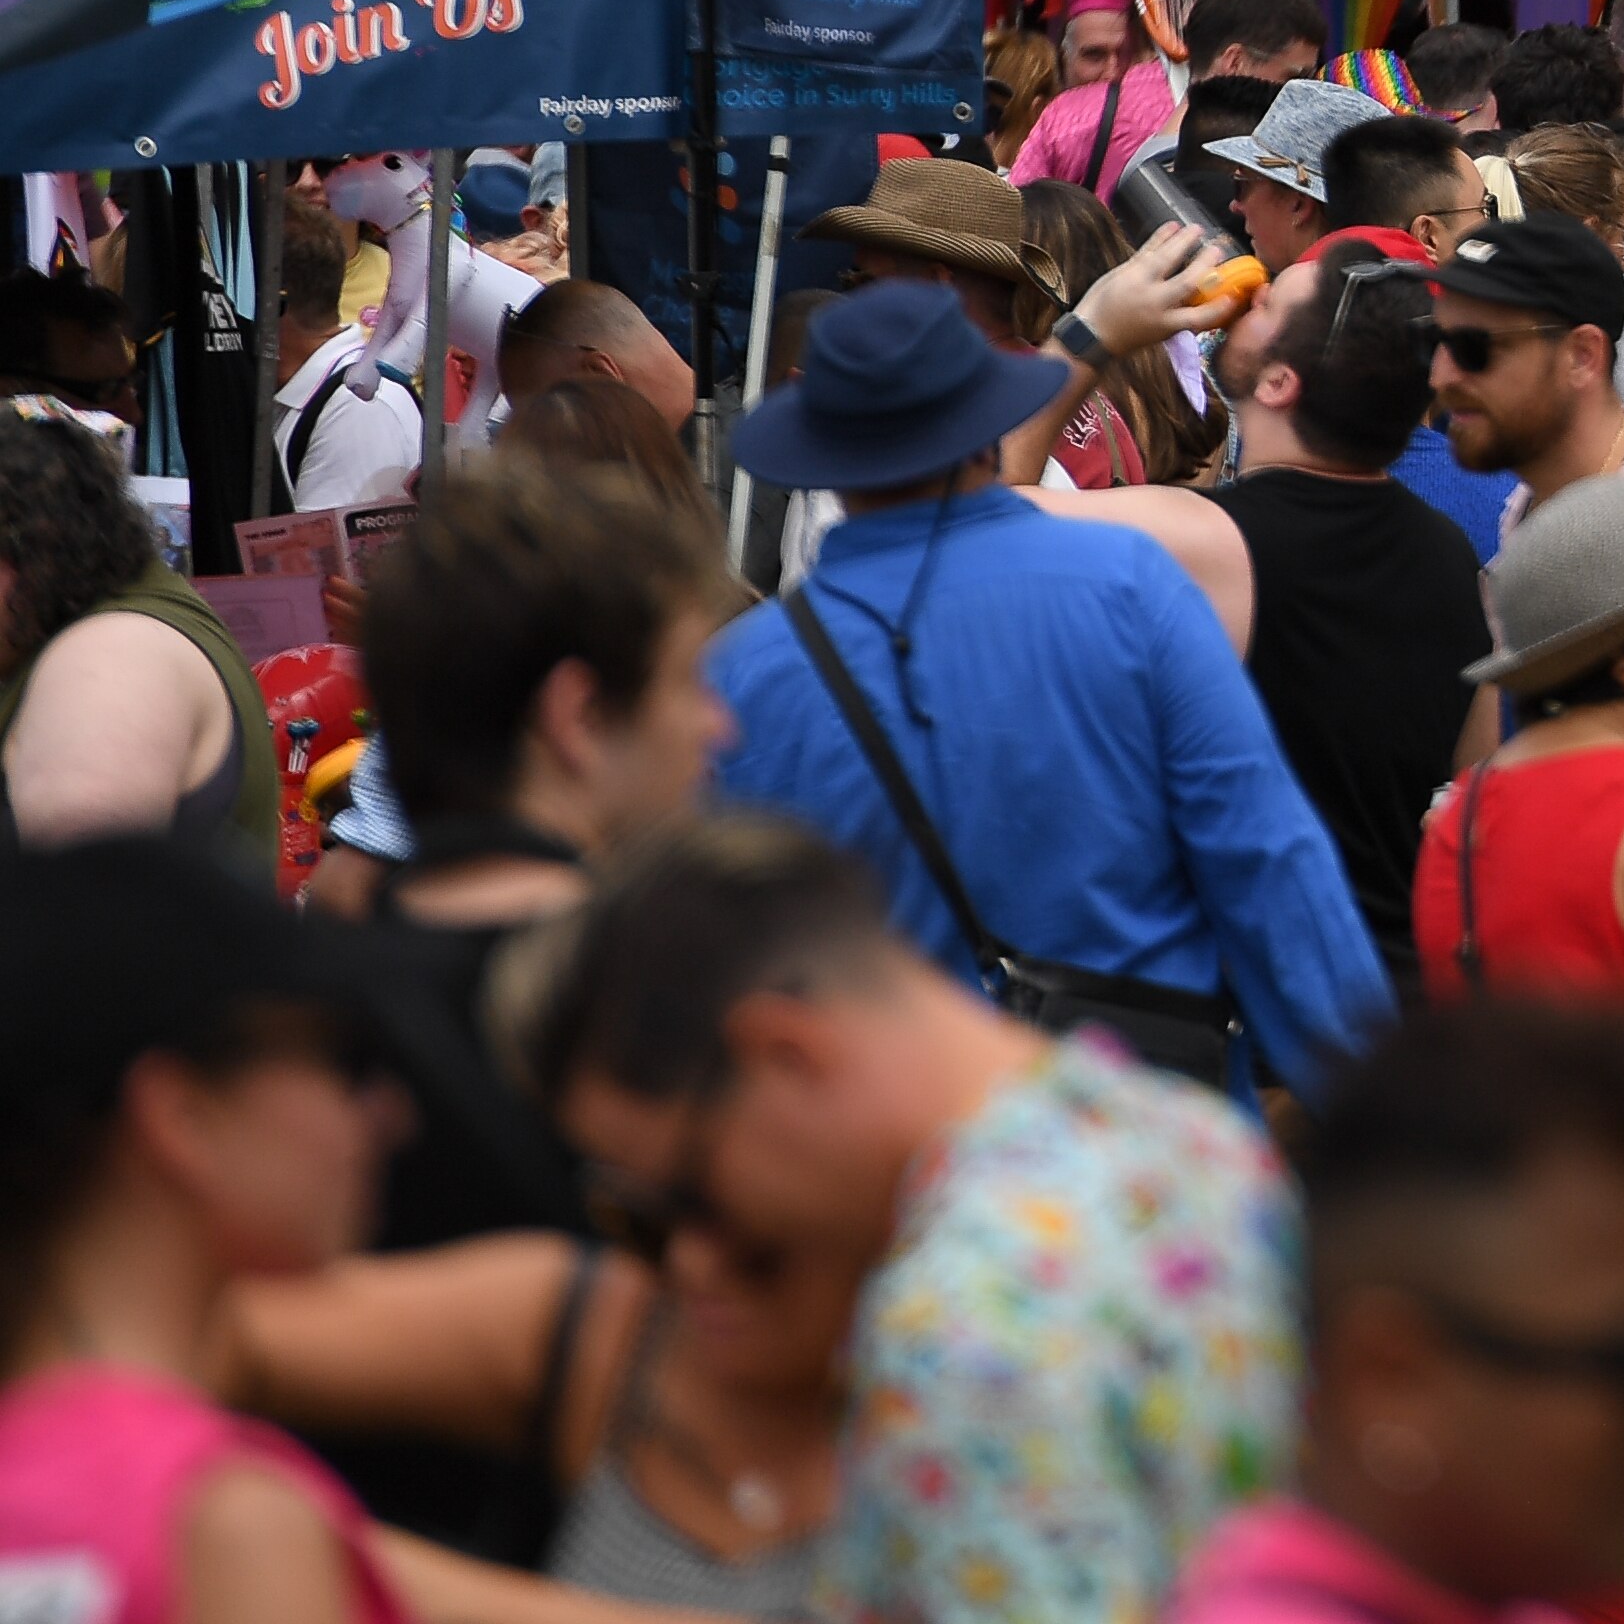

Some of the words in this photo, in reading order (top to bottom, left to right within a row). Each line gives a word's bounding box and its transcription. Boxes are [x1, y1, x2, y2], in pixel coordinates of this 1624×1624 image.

[812, 25, 875, 45] sponsor
[539, 96, 613, 119] Fairday
[795, 85, 820, 107] in
[827, 83, 897, 111] Surry
[903, 82, 958, 107] Hills
